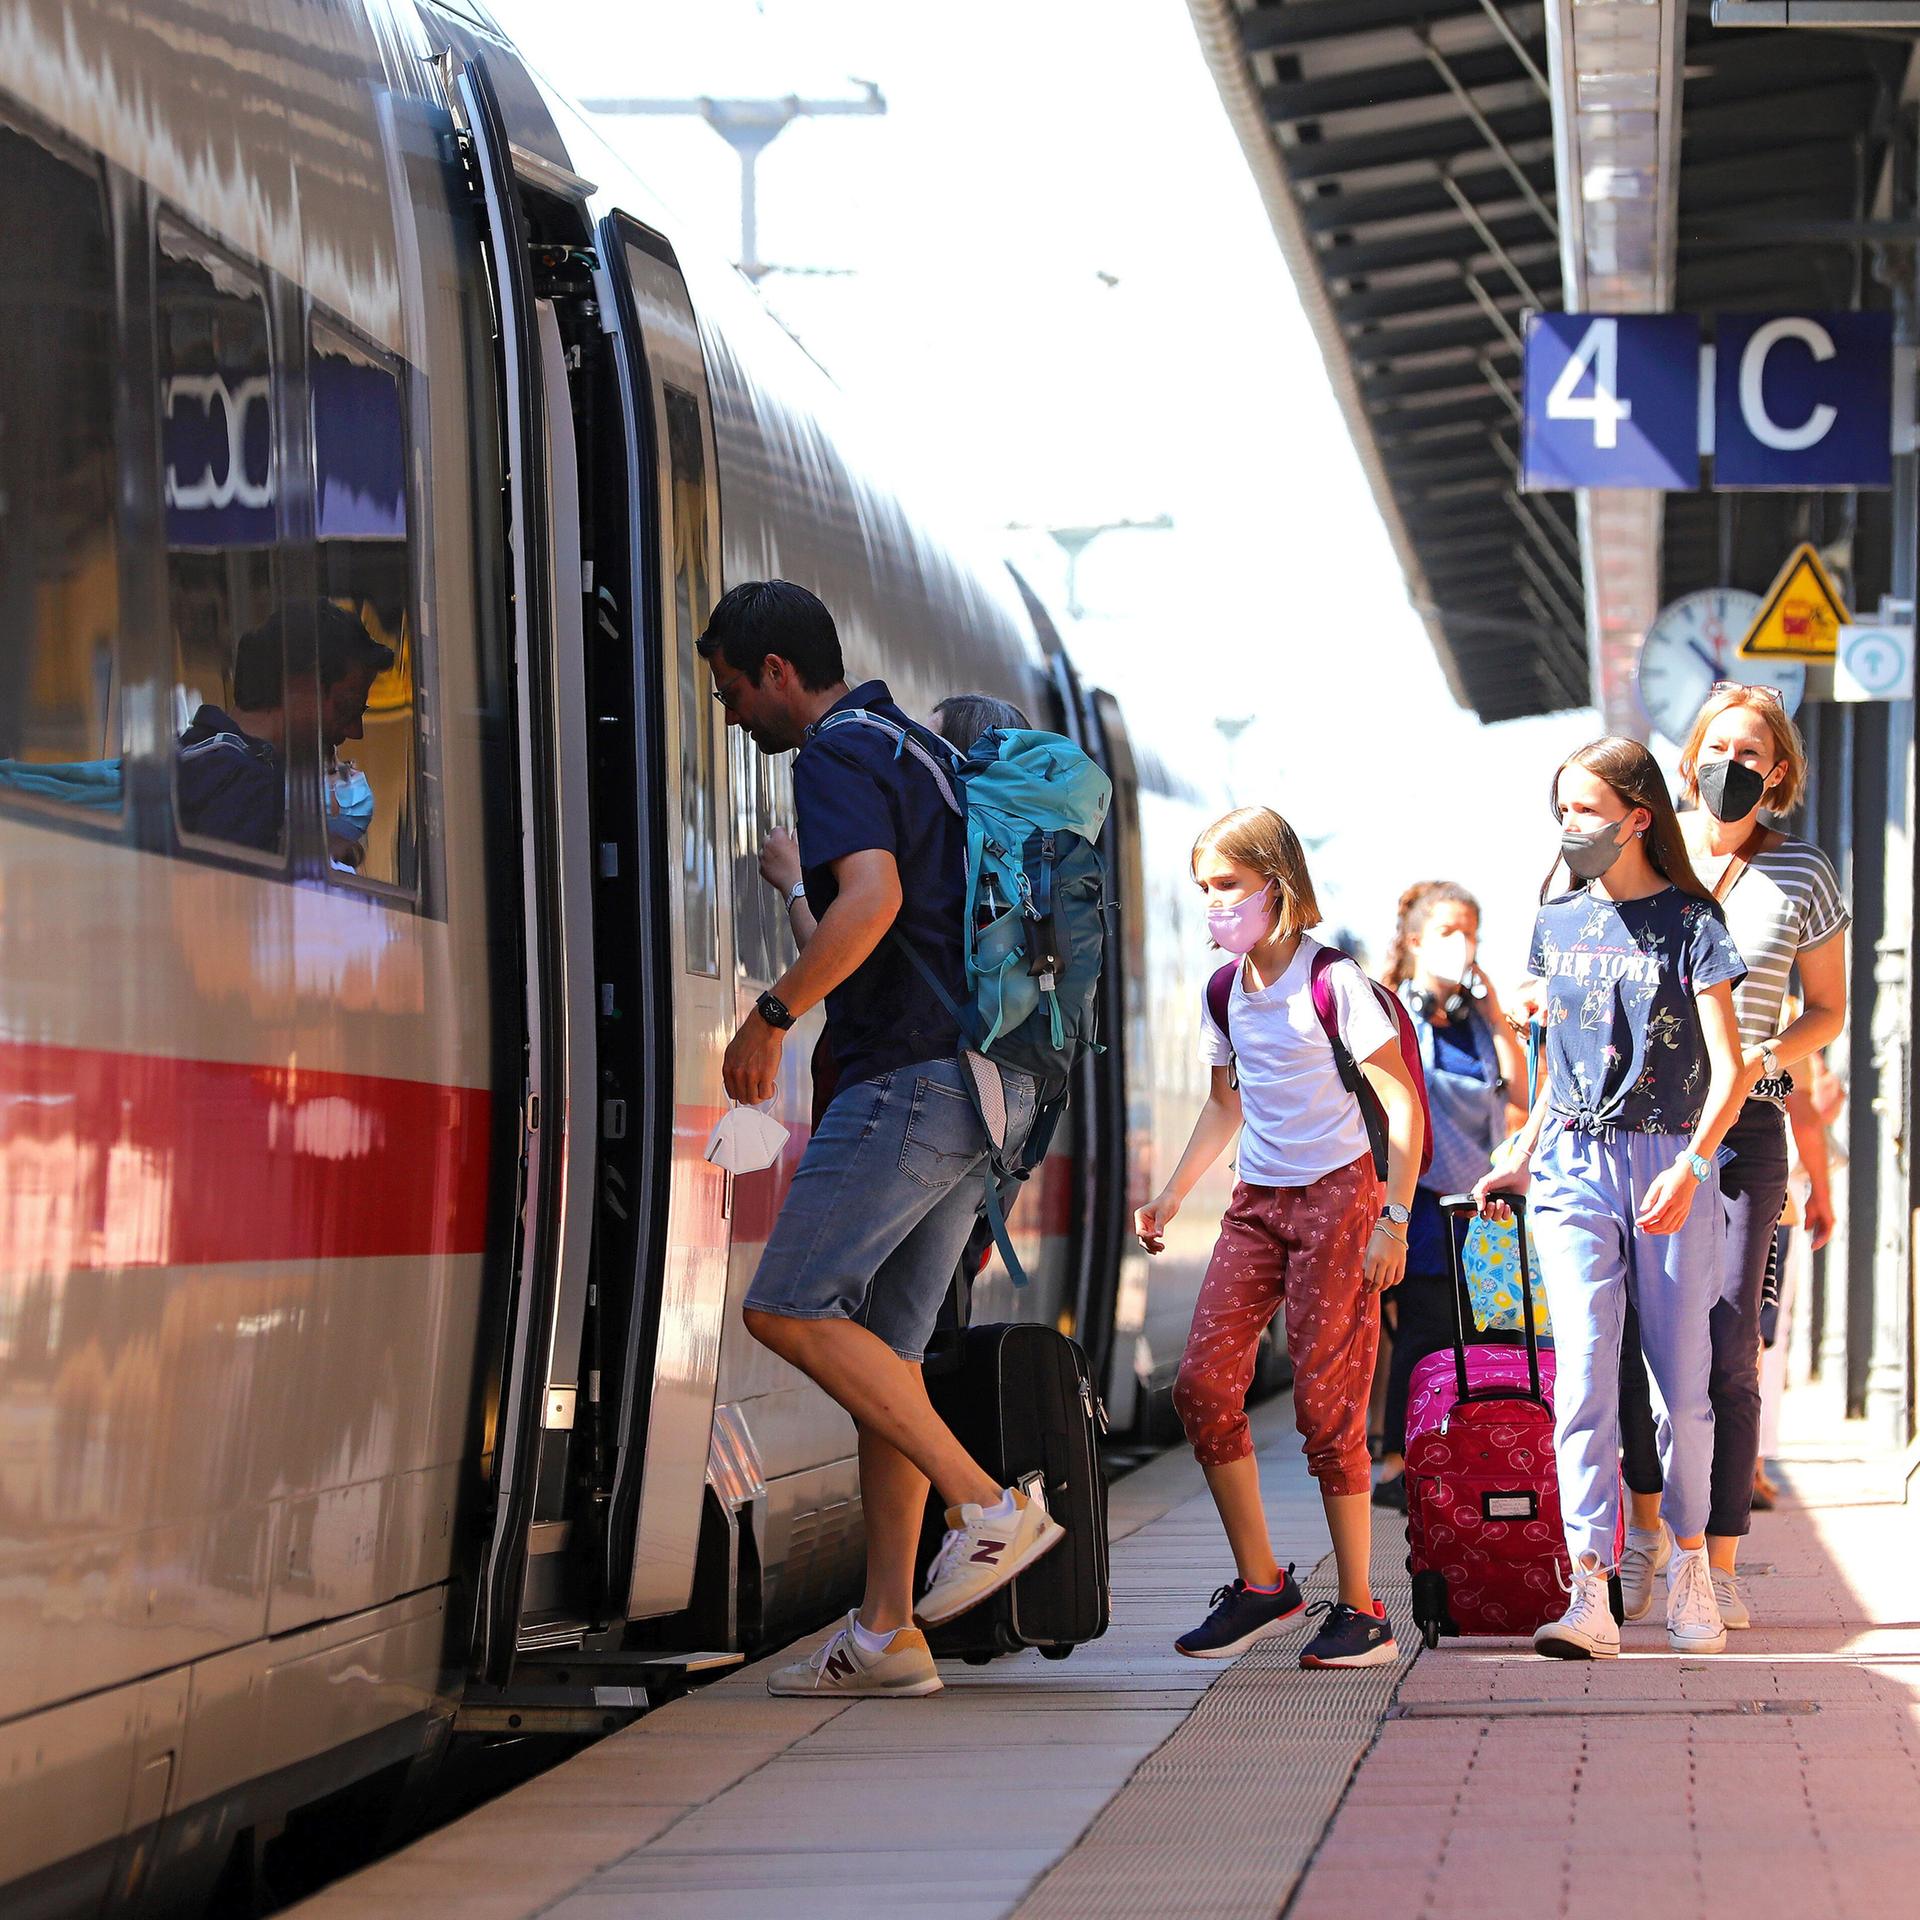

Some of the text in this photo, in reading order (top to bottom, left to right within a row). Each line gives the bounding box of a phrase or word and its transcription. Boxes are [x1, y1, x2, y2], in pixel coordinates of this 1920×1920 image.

[1546, 316, 1838, 451] 4 C
[1545, 951, 1663, 985] NEW YORK
[969, 1539, 1007, 1565] N
[825, 1649, 857, 1680] N
